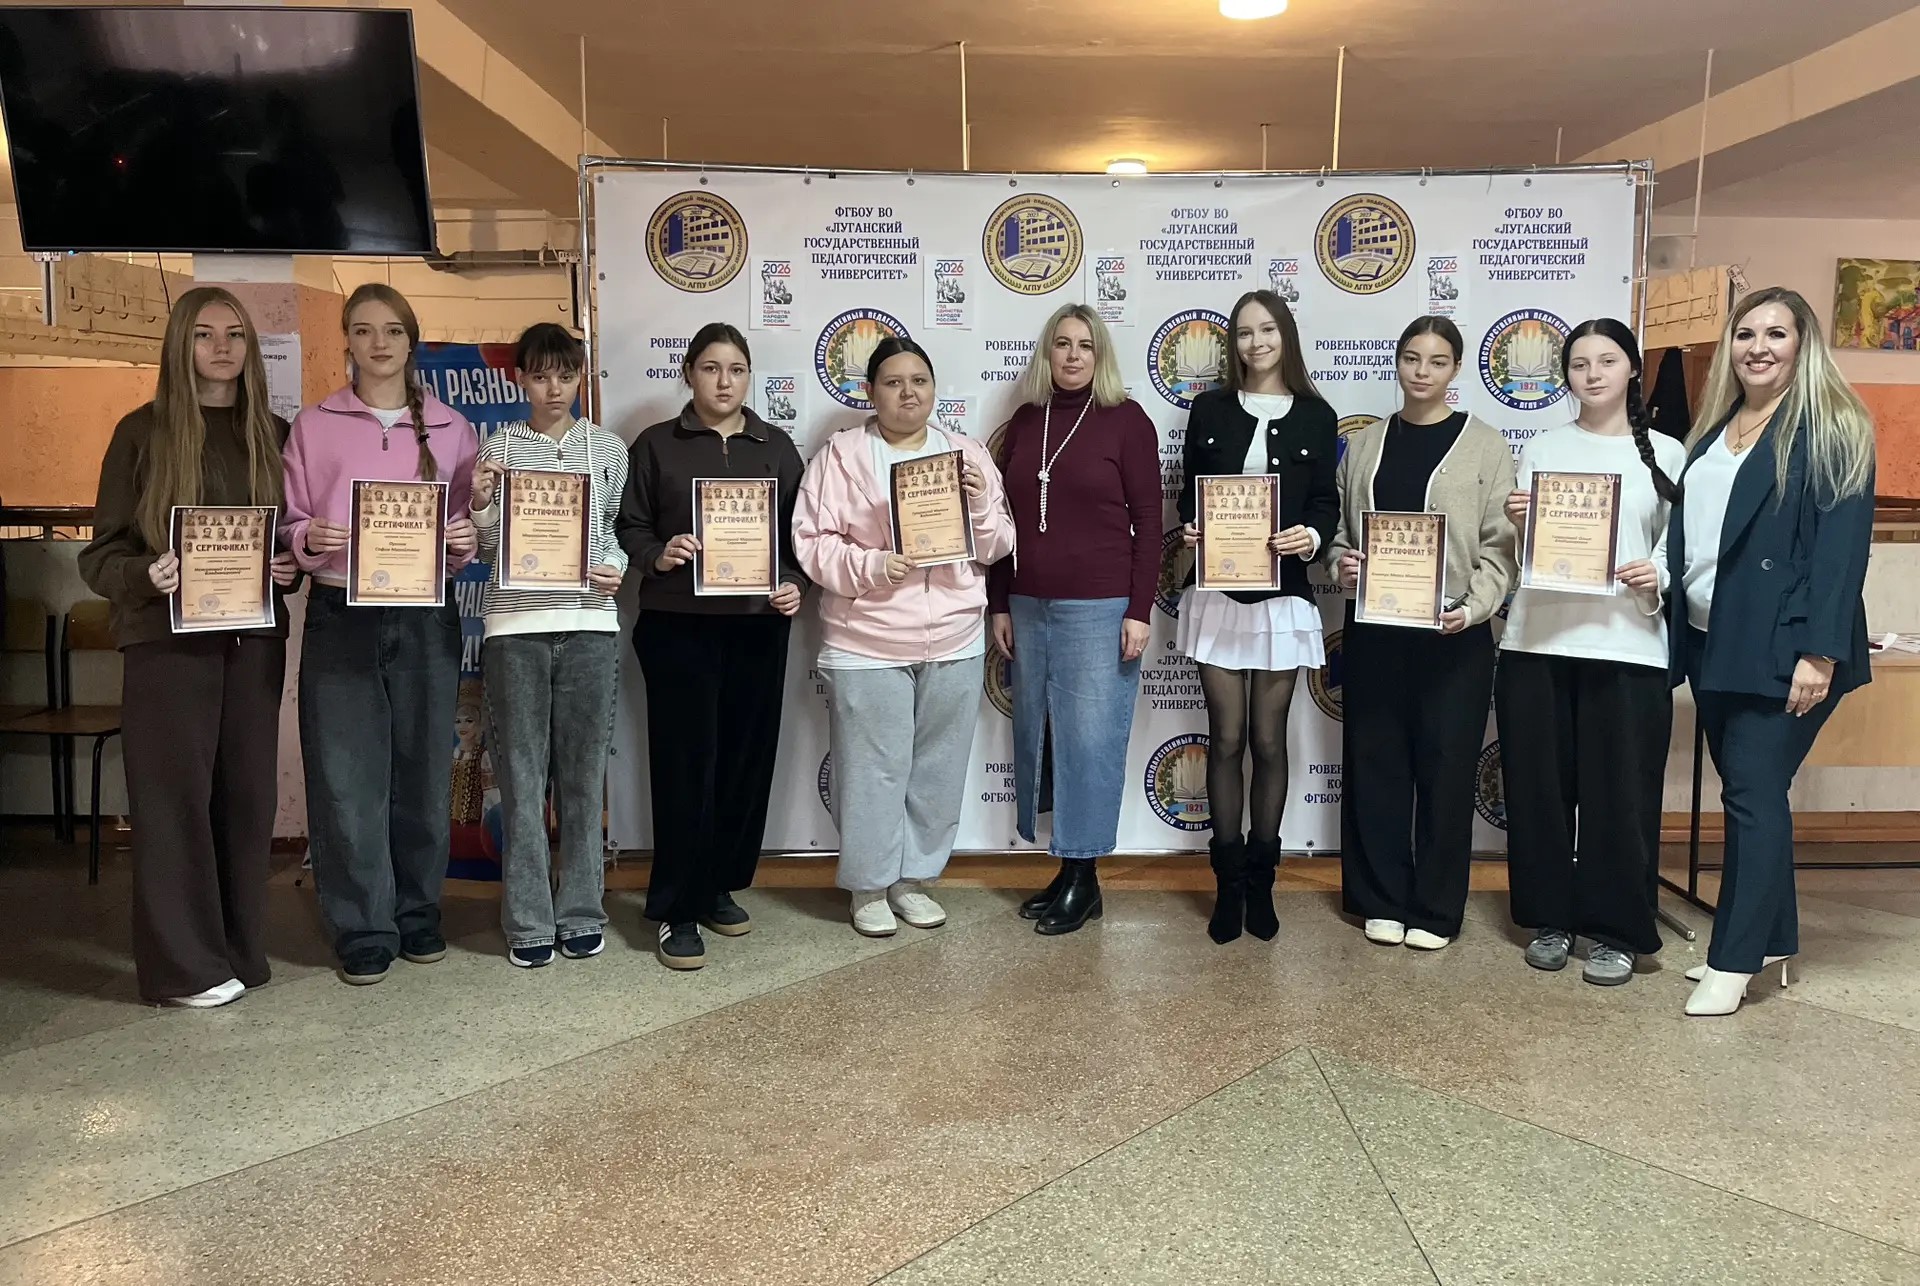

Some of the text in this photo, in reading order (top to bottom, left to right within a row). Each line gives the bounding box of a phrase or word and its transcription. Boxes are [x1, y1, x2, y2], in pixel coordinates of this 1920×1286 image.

[835, 206, 893, 218] ФГБОУ ВО
[1171, 208, 1229, 219] ФГБОУ ВО
[1504, 207, 1563, 219] ФГБОУ ВО
[825, 221, 902, 233] «ЛУГАНСКИЙ
[1161, 222, 1238, 234] «ЛУГАНСКИЙ
[1494, 222, 1571, 234] «ЛУГАНСКИЙ
[804, 237, 920, 251] ГОСУДАРСТВЕННЫЙ
[1139, 238, 1255, 252] ГОСУДАРСТВЕННЫЙ
[1472, 237, 1589, 251] ГОСУДАРСТВЕННЫЙ
[811, 252, 917, 266] ПЕДАГОГИЧЕСКИЙ
[1147, 253, 1252, 267] ПЕДАГОГИЧЕСКИЙ
[1479, 253, 1585, 267] ПЕДАГОГИЧЕСКИЙ
[763, 263, 791, 274] 2026
[936, 262, 964, 273] 2026
[1097, 260, 1125, 271] 2026
[1270, 262, 1298, 272] 2026
[1429, 260, 1457, 270] 2026
[821, 269, 908, 280] УНИВЕРСИТЕТ»
[1156, 270, 1243, 281] УНИВЕРСИТЕТ»
[1488, 270, 1576, 280] УНИВЕРСИТЕТ»
[1150, 311, 1197, 365] ГОСУДАРСТВЕННЫЙ
[985, 340, 1036, 351] РОВЕНЬК
[1315, 339, 1398, 351] РОВЕНЬКОВСК
[263, 353, 287, 361] ожаре
[816, 310, 908, 403] ЛУГАНСКИЙ ГОСУДАРСТВЕННЫЙ ПЕДАГОГИЧЕ
[1333, 355, 1393, 367] КОЛЛЕДЖ
[1480, 311, 1571, 404] ЛУГАНСКИЙ ГОСУДАРСТВЕННЫЙ ПЕДАГОГИЧ
[981, 371, 1019, 381] ФГБОУ
[1310, 370, 1349, 381] ФГБОУ
[1353, 371, 1368, 381] ВО
[445, 367, 530, 405] РАЗНЫ
[767, 380, 795, 390] 2026
[1150, 369, 1180, 404] ЛУГАНСКИЙ
[1188, 382, 1207, 391] 1921
[1520, 382, 1538, 390] 1921
[1446, 392, 1459, 401] 26
[938, 403, 966, 413] 2026
[907, 487, 948, 498] СЕРТИФИКАТ
[523, 508, 569, 516] СЕРТИФИКАТ
[1549, 510, 1598, 519] СЕРТИФИКАТ
[373, 520, 423, 529] СЕРТИФИКАТ
[196, 544, 250, 552] СЕРТИФИКАТ
[1380, 547, 1425, 556] СЕРТИФИКАТ
[1157, 656, 1198, 666] «ЛУГА
[1141, 670, 1200, 681] ОСУДАРСТ
[1143, 685, 1202, 696] ПЕДАГОГИ
[1152, 700, 1207, 710] УНИВЕРС
[1146, 736, 1193, 825] ЛУГАНСКИЙ ГОСУДАРСТВЕННЫЙ
[1185, 803, 1204, 812] 1921
